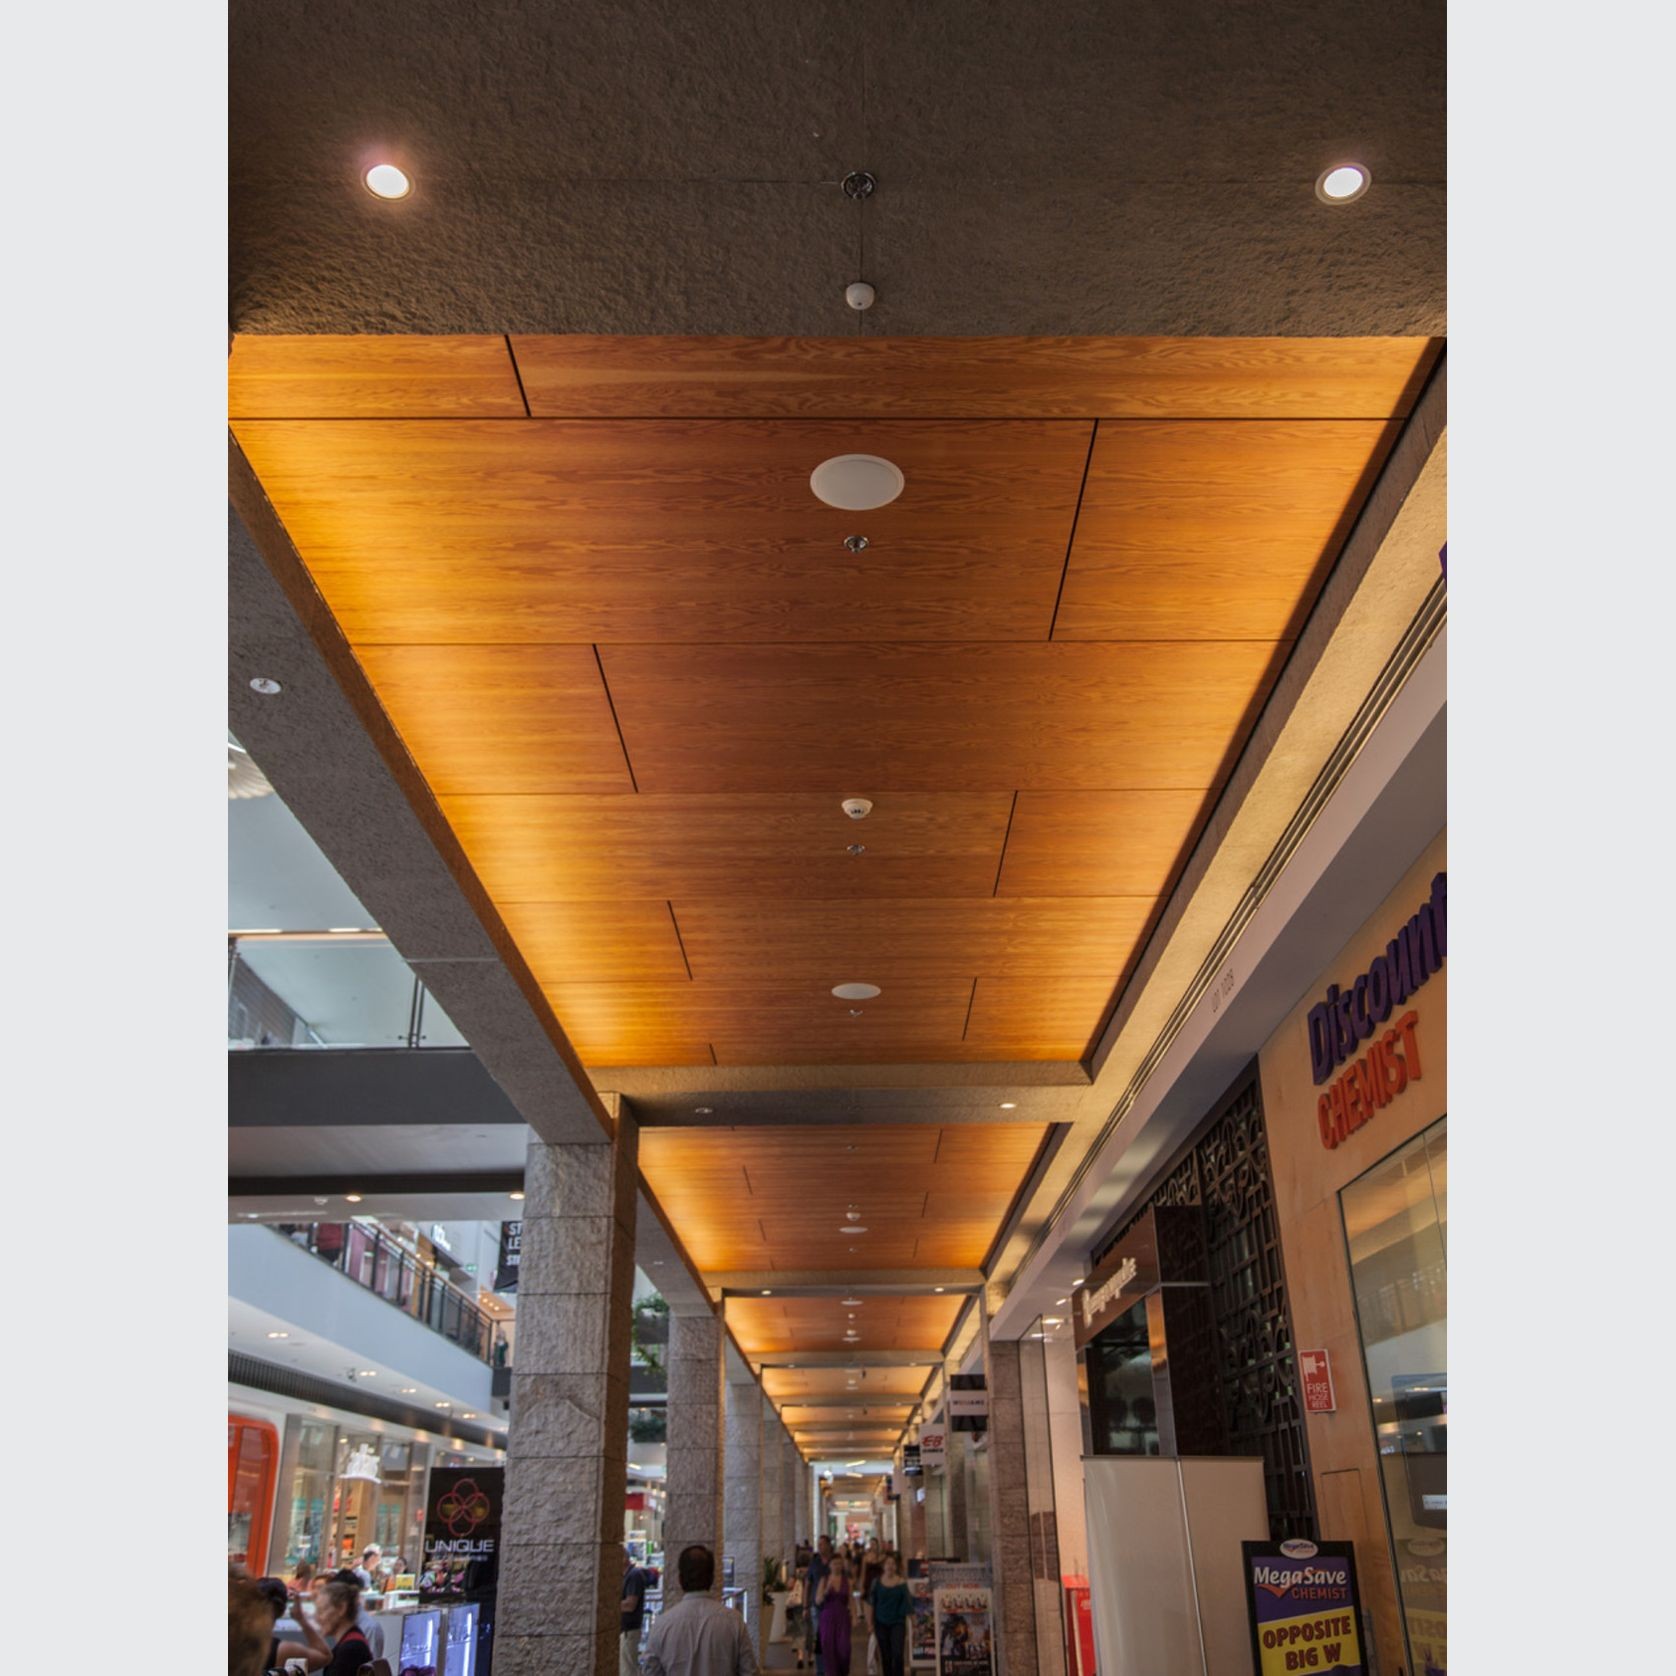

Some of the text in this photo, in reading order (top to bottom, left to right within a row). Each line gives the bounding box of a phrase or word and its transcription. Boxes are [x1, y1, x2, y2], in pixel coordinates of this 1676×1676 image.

[1317, 1010, 1422, 1150] CHEMIST
[1307, 1382, 1328, 1393] FIRE
[425, 1540, 494, 1552] UNIQUE
[1254, 1566, 1347, 1589] MegaSave
[1263, 1616, 1351, 1649] OPPOSITE
[1285, 1643, 1341, 1671] BIG W
